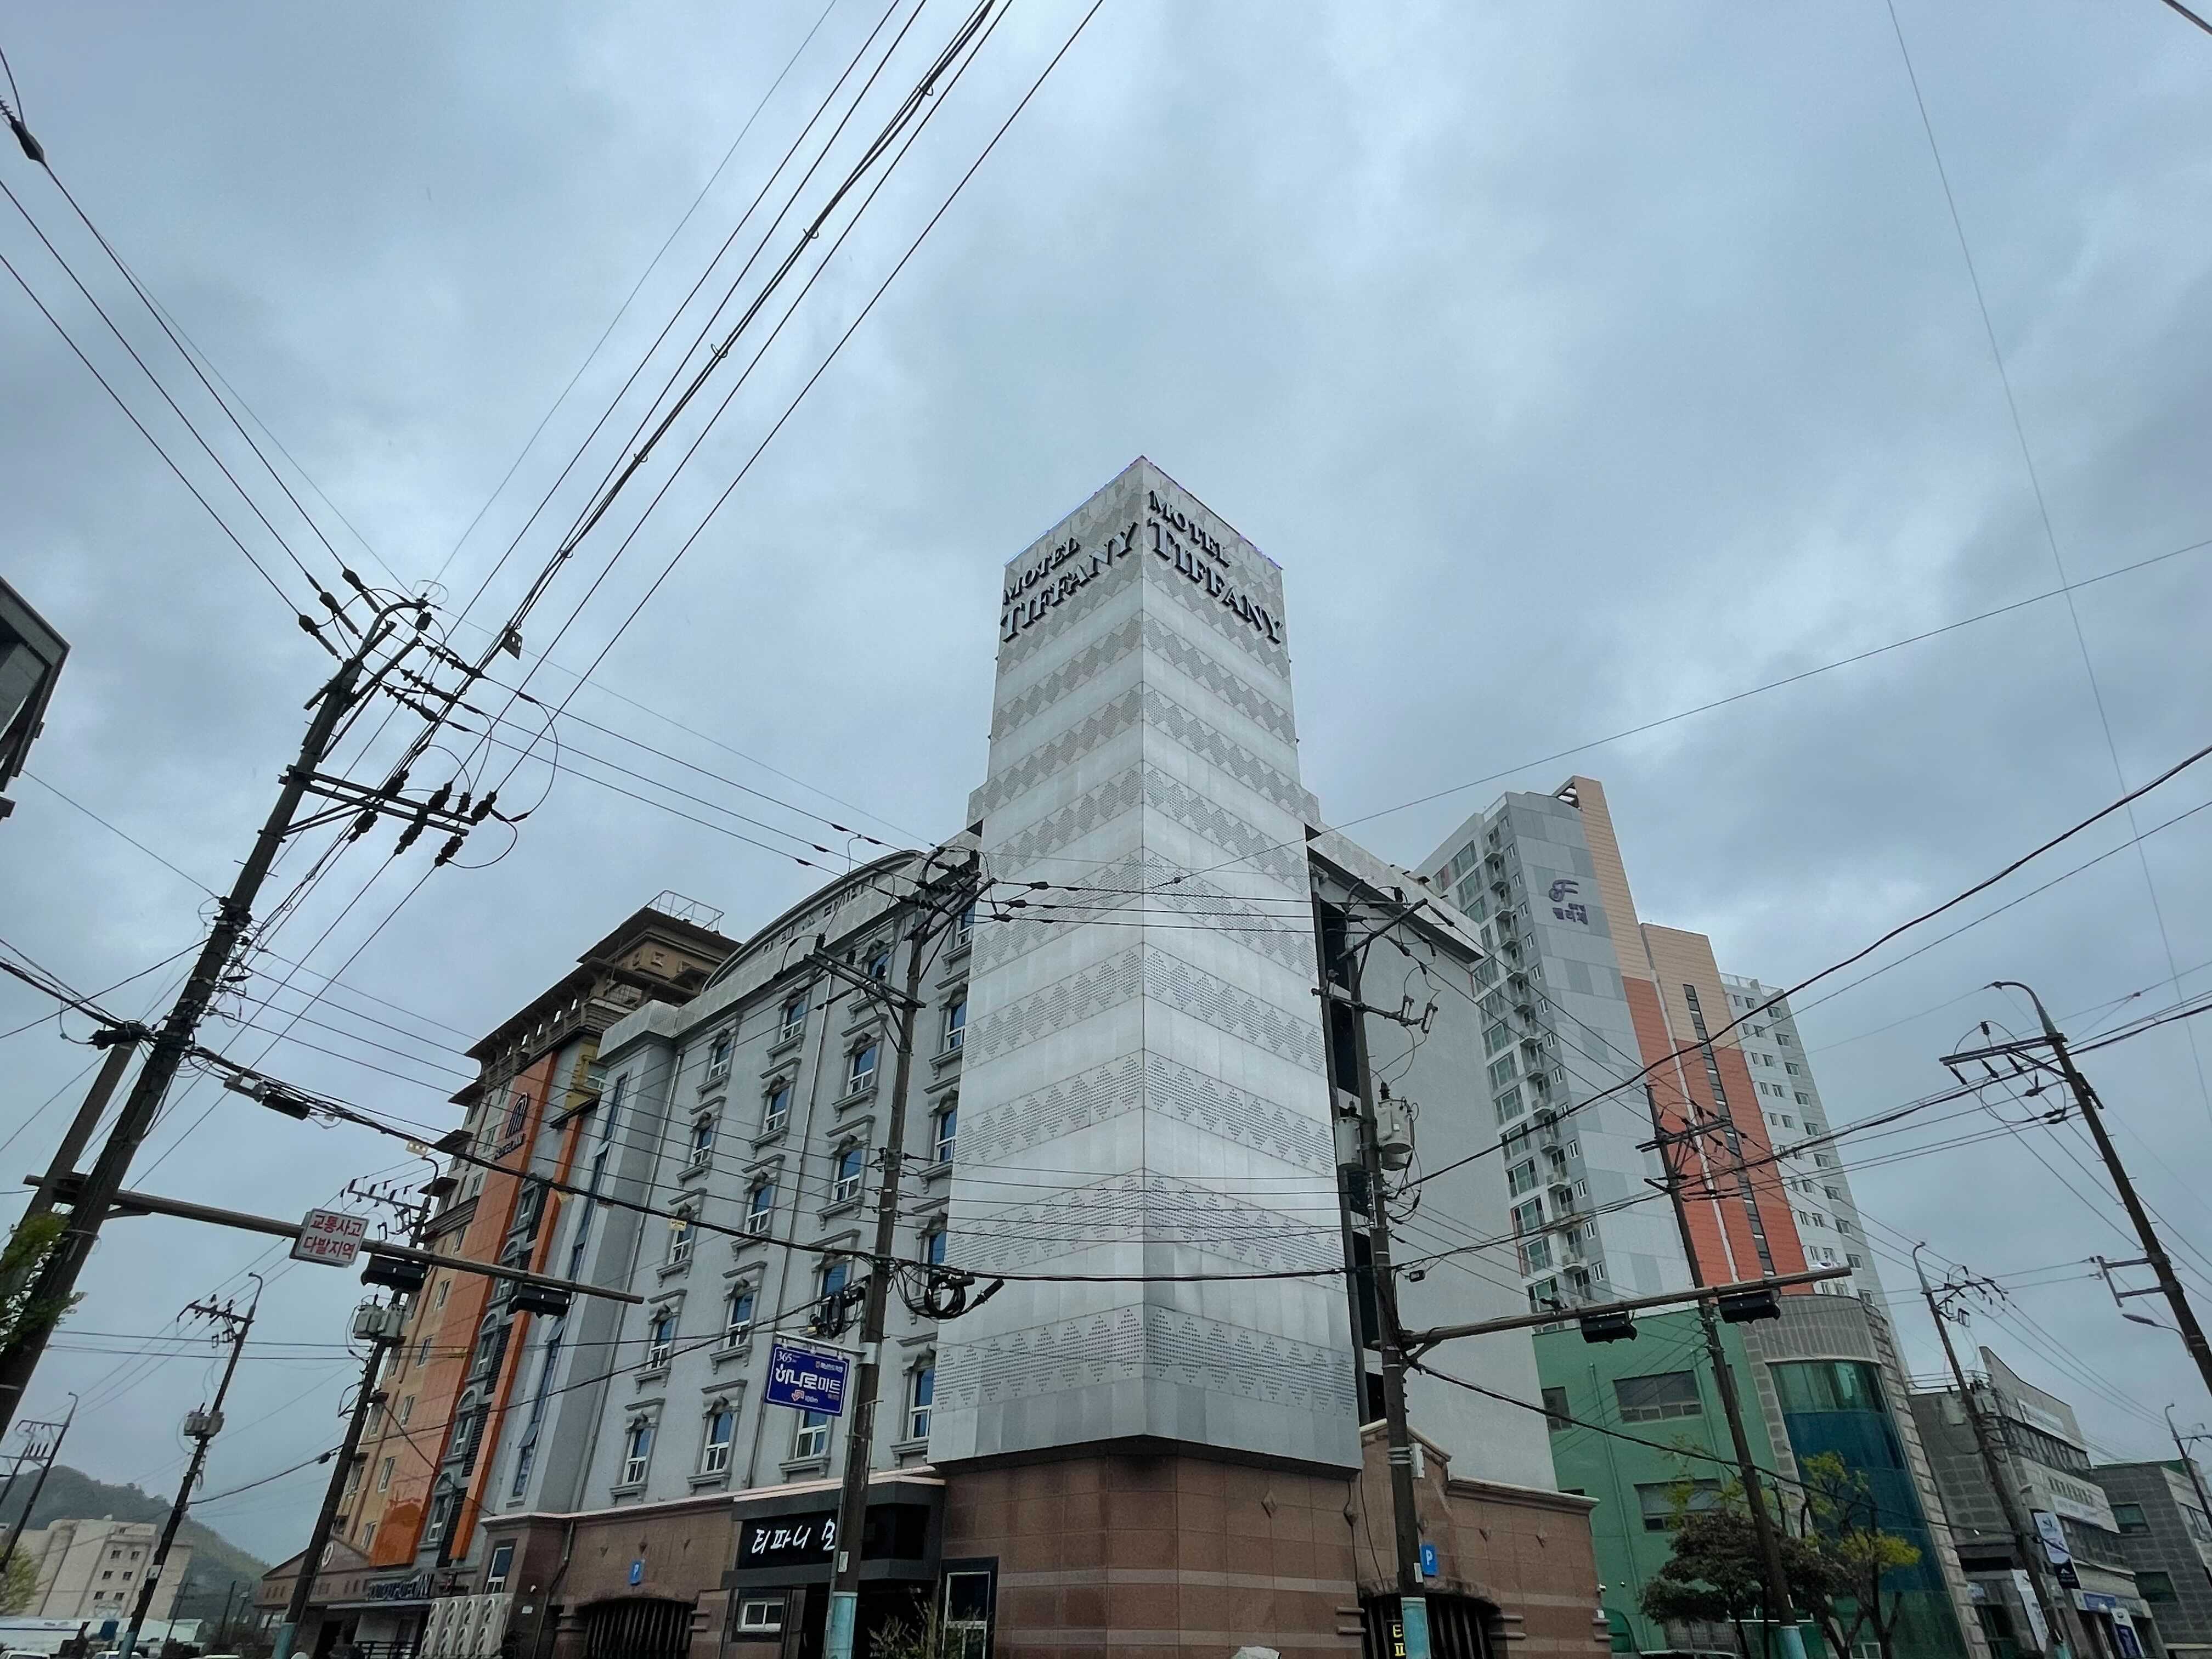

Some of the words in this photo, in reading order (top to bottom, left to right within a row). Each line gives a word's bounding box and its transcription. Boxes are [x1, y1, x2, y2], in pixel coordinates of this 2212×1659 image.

[1150, 490, 1231, 568] MOTEL
[1001, 522, 1138, 642] TIFFANY
[1003, 537, 1081, 604] MOTEL
[1148, 517, 1283, 645] TIFFANY
[310, 1215, 362, 1237] 교통사고
[303, 1235, 356, 1260] 다발지역
[777, 1351, 792, 1363] 365
[775, 1363, 842, 1395] 하나로마트
[752, 1525, 812, 1554] 티파니
[1425, 1549, 1434, 1566] P
